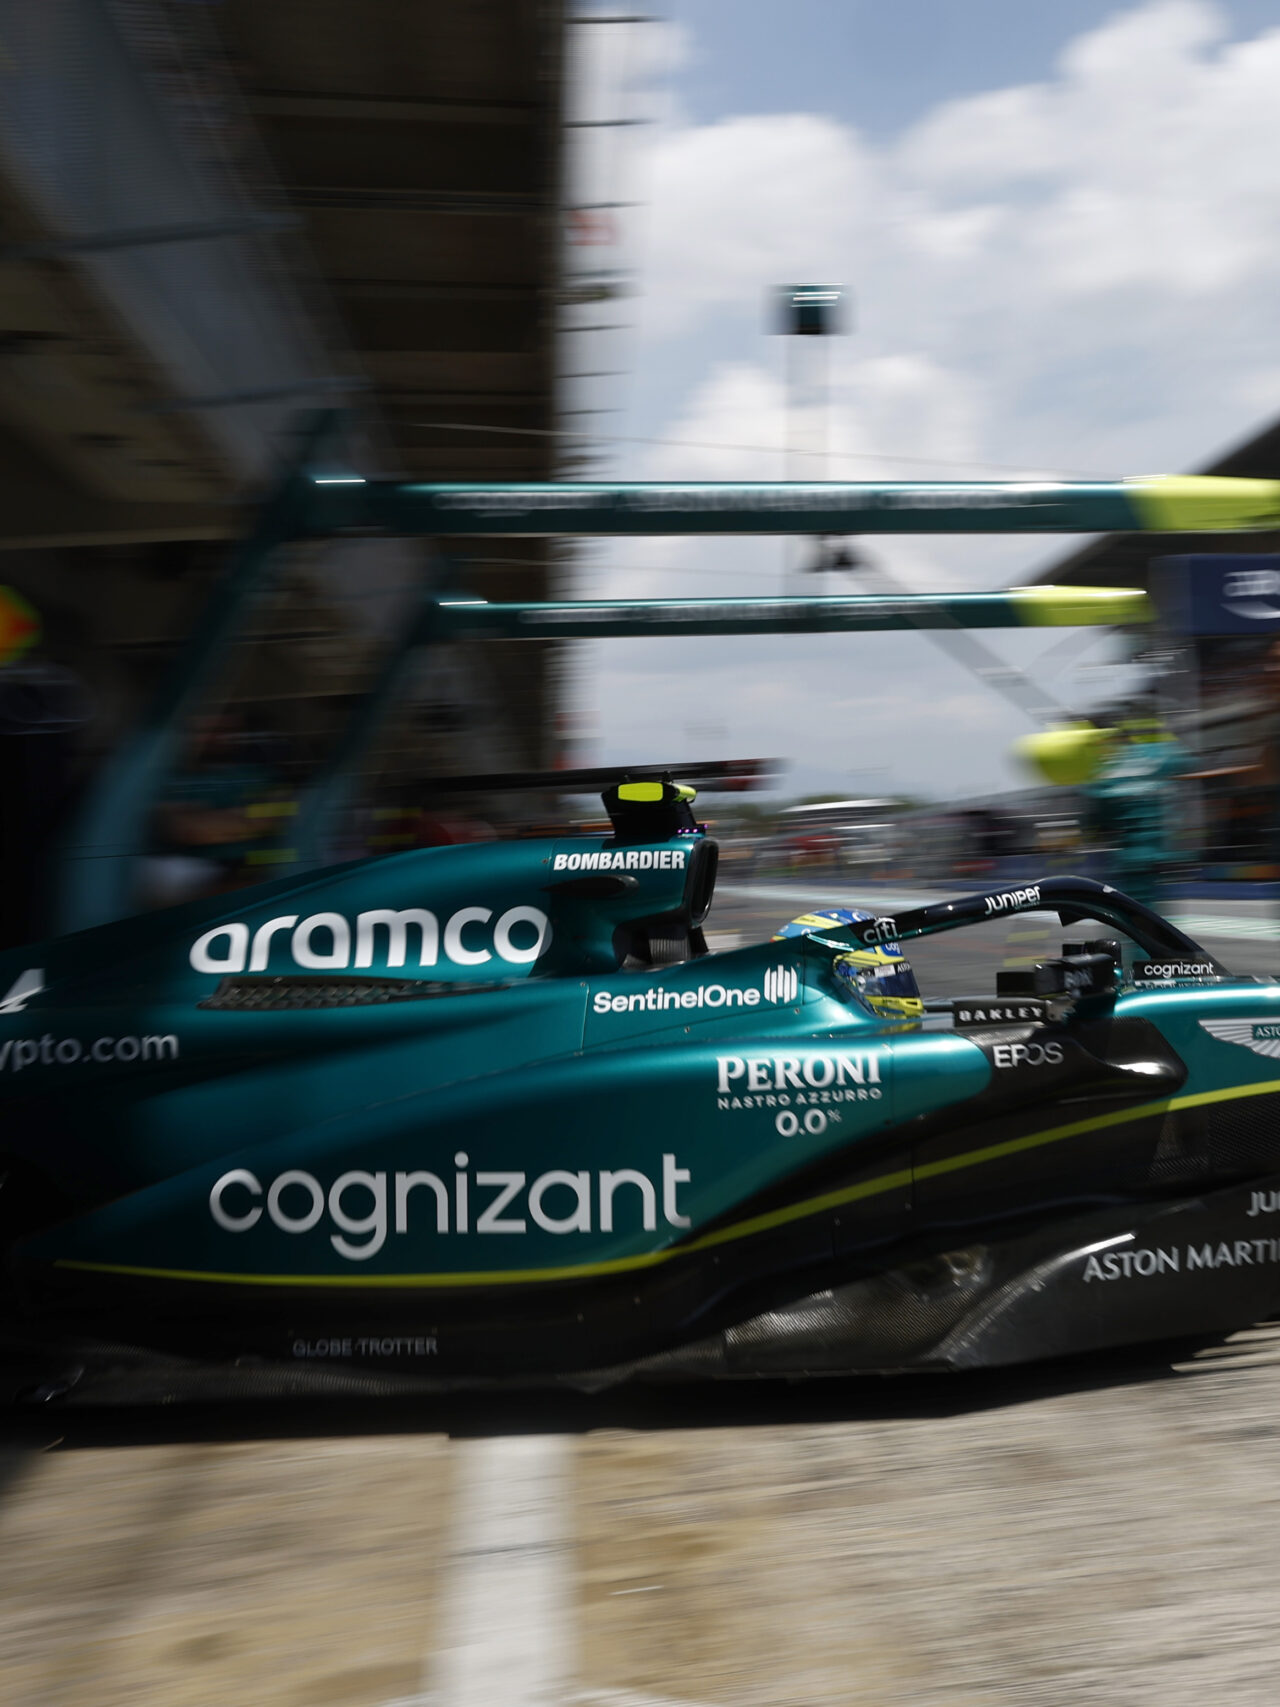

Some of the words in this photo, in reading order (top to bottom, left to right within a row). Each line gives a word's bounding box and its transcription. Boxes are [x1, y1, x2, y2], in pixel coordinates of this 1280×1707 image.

[553, 850, 686, 871] BOMBARDIER
[189, 906, 553, 974] aramco
[863, 918, 899, 944] citi
[1144, 961, 1214, 979] cognizant
[593, 984, 761, 1014] SentinelOne
[959, 1007, 1043, 1021] OAKLEY
[993, 1042, 1064, 1068] EPOS
[716, 1053, 882, 1094] PERONI
[717, 1093, 791, 1110] NASTRO
[795, 1087, 883, 1105] AZZURRO
[209, 1151, 691, 1261] cognizant
[1082, 1245, 1180, 1283] ASTON
